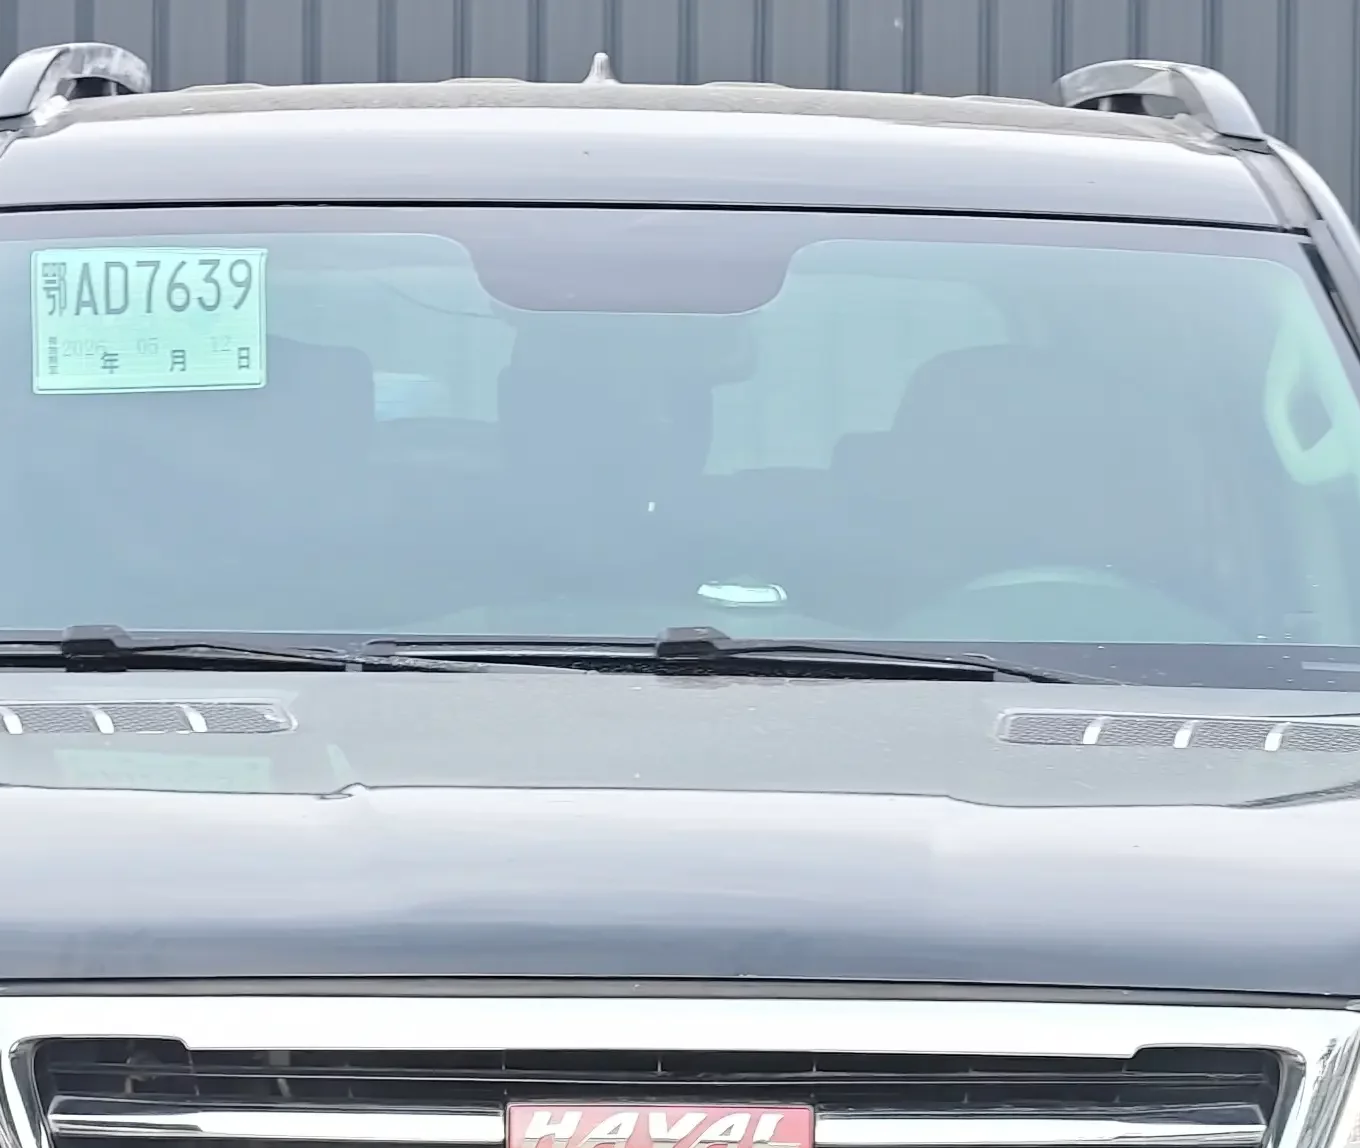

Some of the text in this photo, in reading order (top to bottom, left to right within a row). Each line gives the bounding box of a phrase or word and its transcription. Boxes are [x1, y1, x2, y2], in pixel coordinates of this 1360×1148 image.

[41, 258, 253, 317] 鄂AD7639
[100, 351, 119, 374] 年
[169, 349, 186, 372] 月
[237, 346, 250, 370] 日
